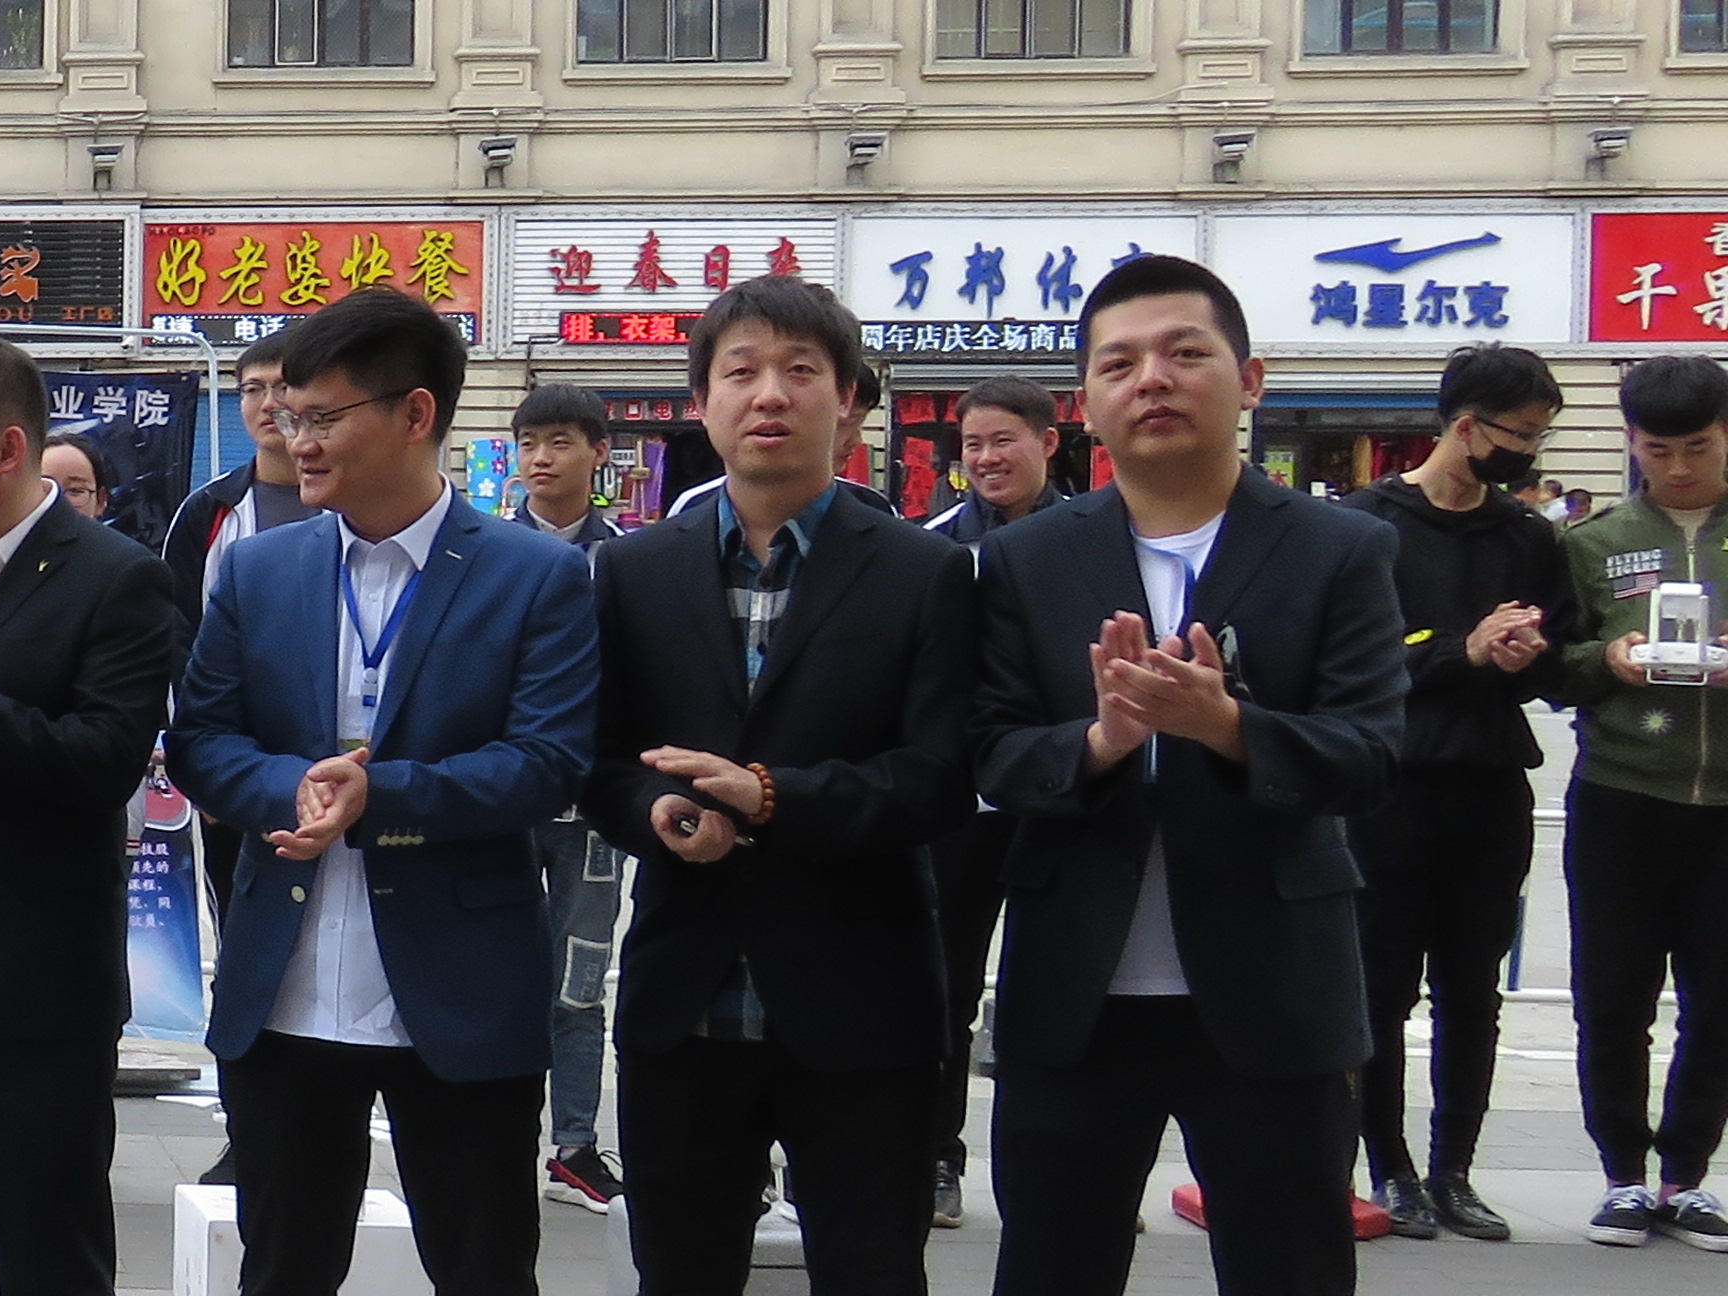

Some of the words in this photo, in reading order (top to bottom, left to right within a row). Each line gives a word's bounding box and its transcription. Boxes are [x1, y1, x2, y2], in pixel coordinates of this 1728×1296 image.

[156, 229, 470, 307] 好老婆快餐
[889, 242, 1156, 320] 万邦体
[1310, 280, 1510, 329] 鸿星尔克
[49, 385, 171, 429] 业学院
